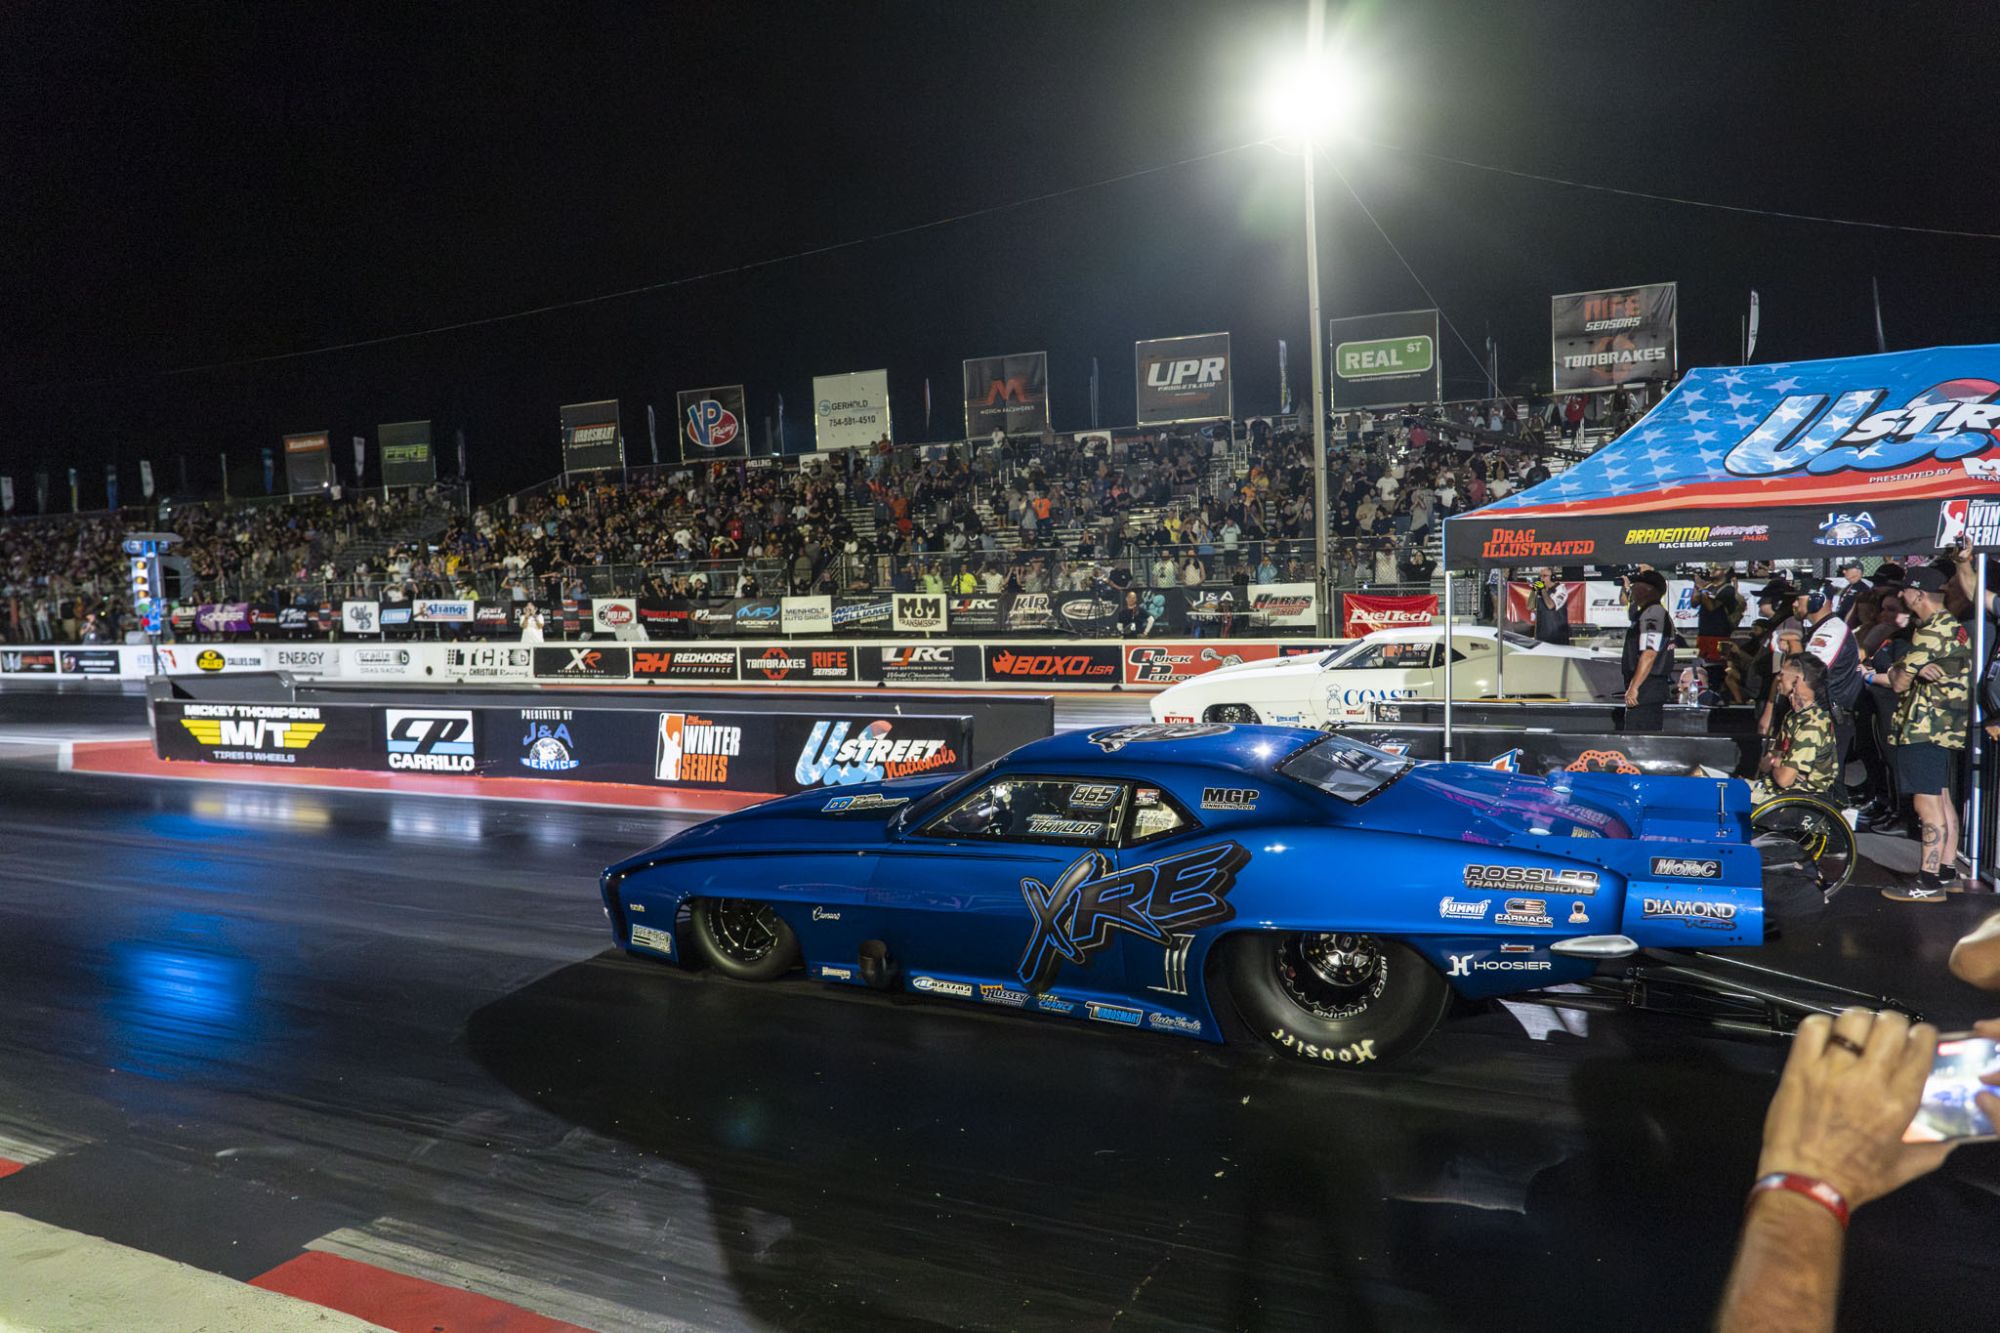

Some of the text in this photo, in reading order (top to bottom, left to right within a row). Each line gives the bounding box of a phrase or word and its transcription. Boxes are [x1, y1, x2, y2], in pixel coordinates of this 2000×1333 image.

[1584, 316, 1642, 332] SENSORS
[1344, 342, 1422, 370] REAL ST
[1147, 357, 1226, 387] UPR
[687, 400, 723, 447] VP
[1840, 401, 2000, 443] STR
[1869, 470, 1934, 483] PRESENTED
[1935, 467, 1953, 476] BY
[1968, 506, 2000, 526] WIN
[1491, 528, 1536, 543] DRAG
[1625, 527, 1710, 544] BRADENTON
[1814, 536, 1881, 546] SERVICE
[1965, 526, 2000, 546] SERI
[1482, 541, 1594, 558] ILLUSTRATED
[1658, 541, 1733, 549] RACEBMP.com
[899, 618, 941, 628] TRANSMISSION
[1350, 609, 1432, 623] FuelTech
[278, 651, 325, 664] ENERGY
[673, 652, 736, 664] REDHORSE
[812, 652, 848, 667] RIFE
[1129, 647, 1193, 666] QUICK
[469, 668, 498, 676] CHRISTIAN
[813, 668, 848, 676] SENSORS
[1011, 656, 1115, 675] BOXO USA
[184, 704, 320, 719] MICKEY THOMPSON
[521, 709, 573, 720] PRESENTED BY
[219, 719, 293, 749] M/T
[522, 721, 574, 749] J&A
[684, 726, 742, 756] WINTER
[213, 750, 244, 760] TIRES
[253, 752, 296, 763] WHEELS
[834, 739, 946, 763] STREET
[388, 753, 475, 771] CARRILLO
[522, 757, 579, 770] SERVICE
[681, 753, 729, 782] SERIES
[884, 745, 956, 780] Nationals
[1070, 785, 1120, 804] 865
[1202, 787, 1260, 804] MGP
[1028, 820, 1104, 836] TAYLOR
[1464, 864, 1599, 886] ROSSLER
[1654, 858, 1717, 877] MoTeC
[1464, 879, 1596, 895] TRANSMISSIONS
[1017, 841, 1250, 987] XRE
[1643, 898, 1737, 919] DIAMOND
[1494, 913, 1552, 924] CARMACK
[1474, 961, 1552, 970] HOOSIER
[1313, 1002, 1369, 1019] RACING
